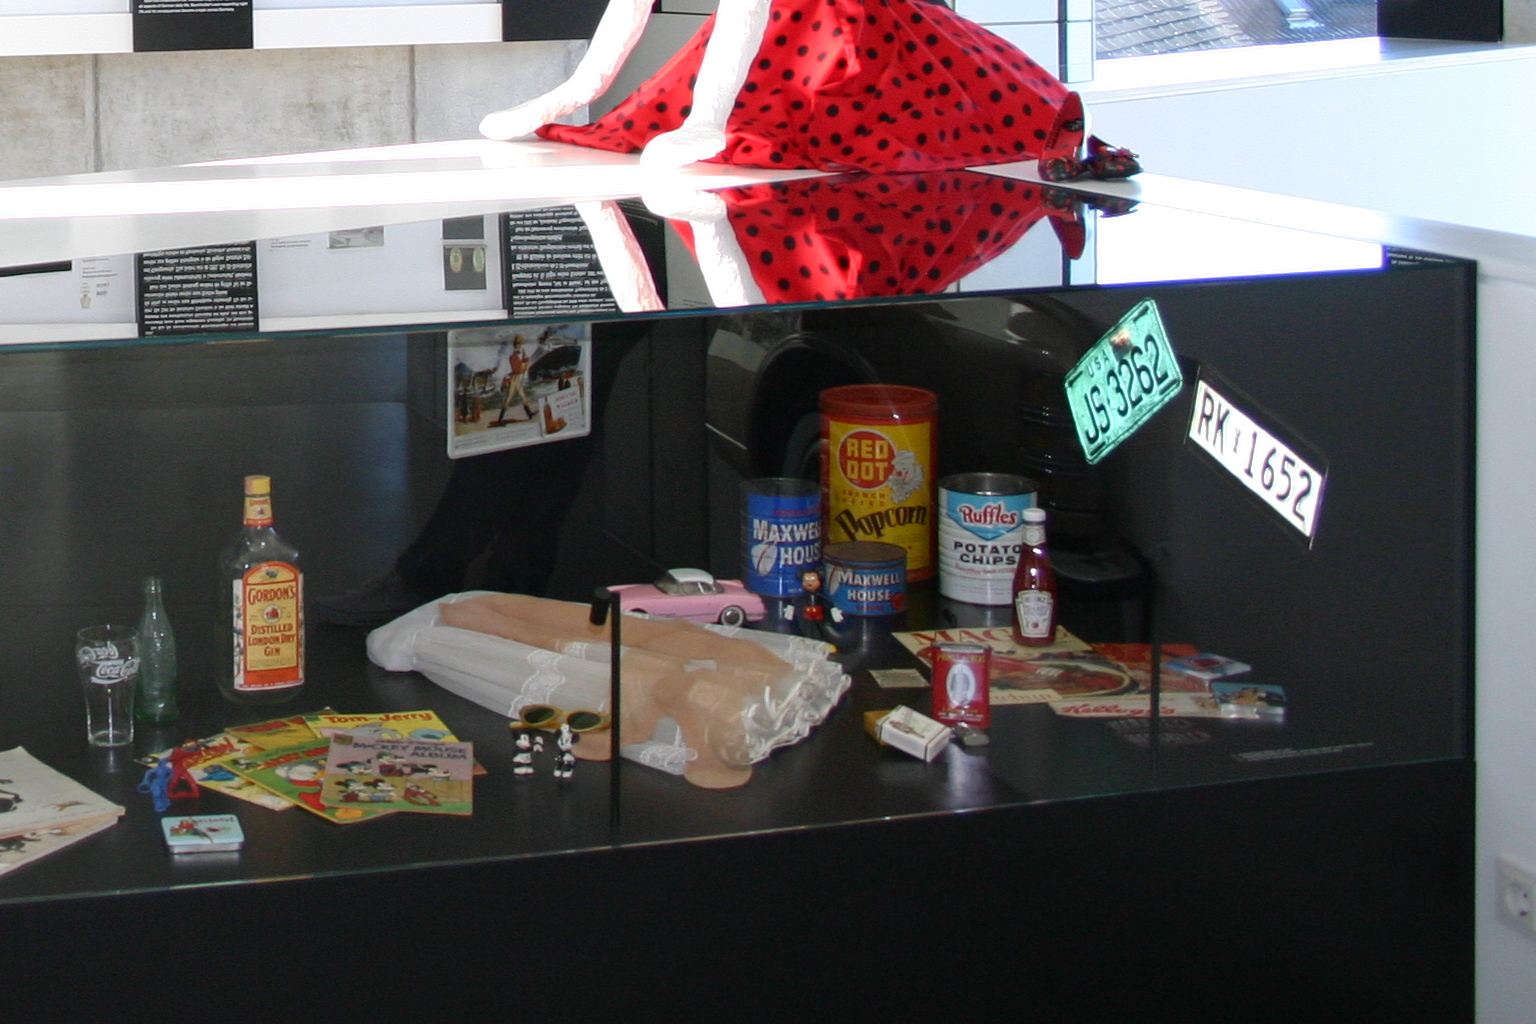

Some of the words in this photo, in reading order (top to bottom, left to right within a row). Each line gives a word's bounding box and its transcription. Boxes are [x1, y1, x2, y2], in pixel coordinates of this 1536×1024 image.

[1088, 350, 1110, 378] USA
[1106, 333, 1168, 418] 3262
[846, 438, 888, 459] RED
[1198, 387, 1231, 455] RK
[1244, 430, 1313, 523] 1652
[846, 461, 889, 481] DOT
[834, 505, 927, 542] Popcorn
[958, 501, 1017, 526] Ruffles
[780, 542, 821, 565] HOUS
[953, 541, 1022, 555] POTATO
[960, 553, 1017, 566] CHIPS
[838, 568, 900, 586] MAXWELL
[248, 585, 296, 605] GORDON'S
[847, 589, 892, 602] HOUSE
[251, 623, 293, 635] DISTILLED
[247, 636, 280, 646] LONDON
[281, 633, 296, 643] DRY
[264, 646, 280, 657] GIN
[324, 716, 369, 724] Tom
[379, 712, 433, 723] Jerry
